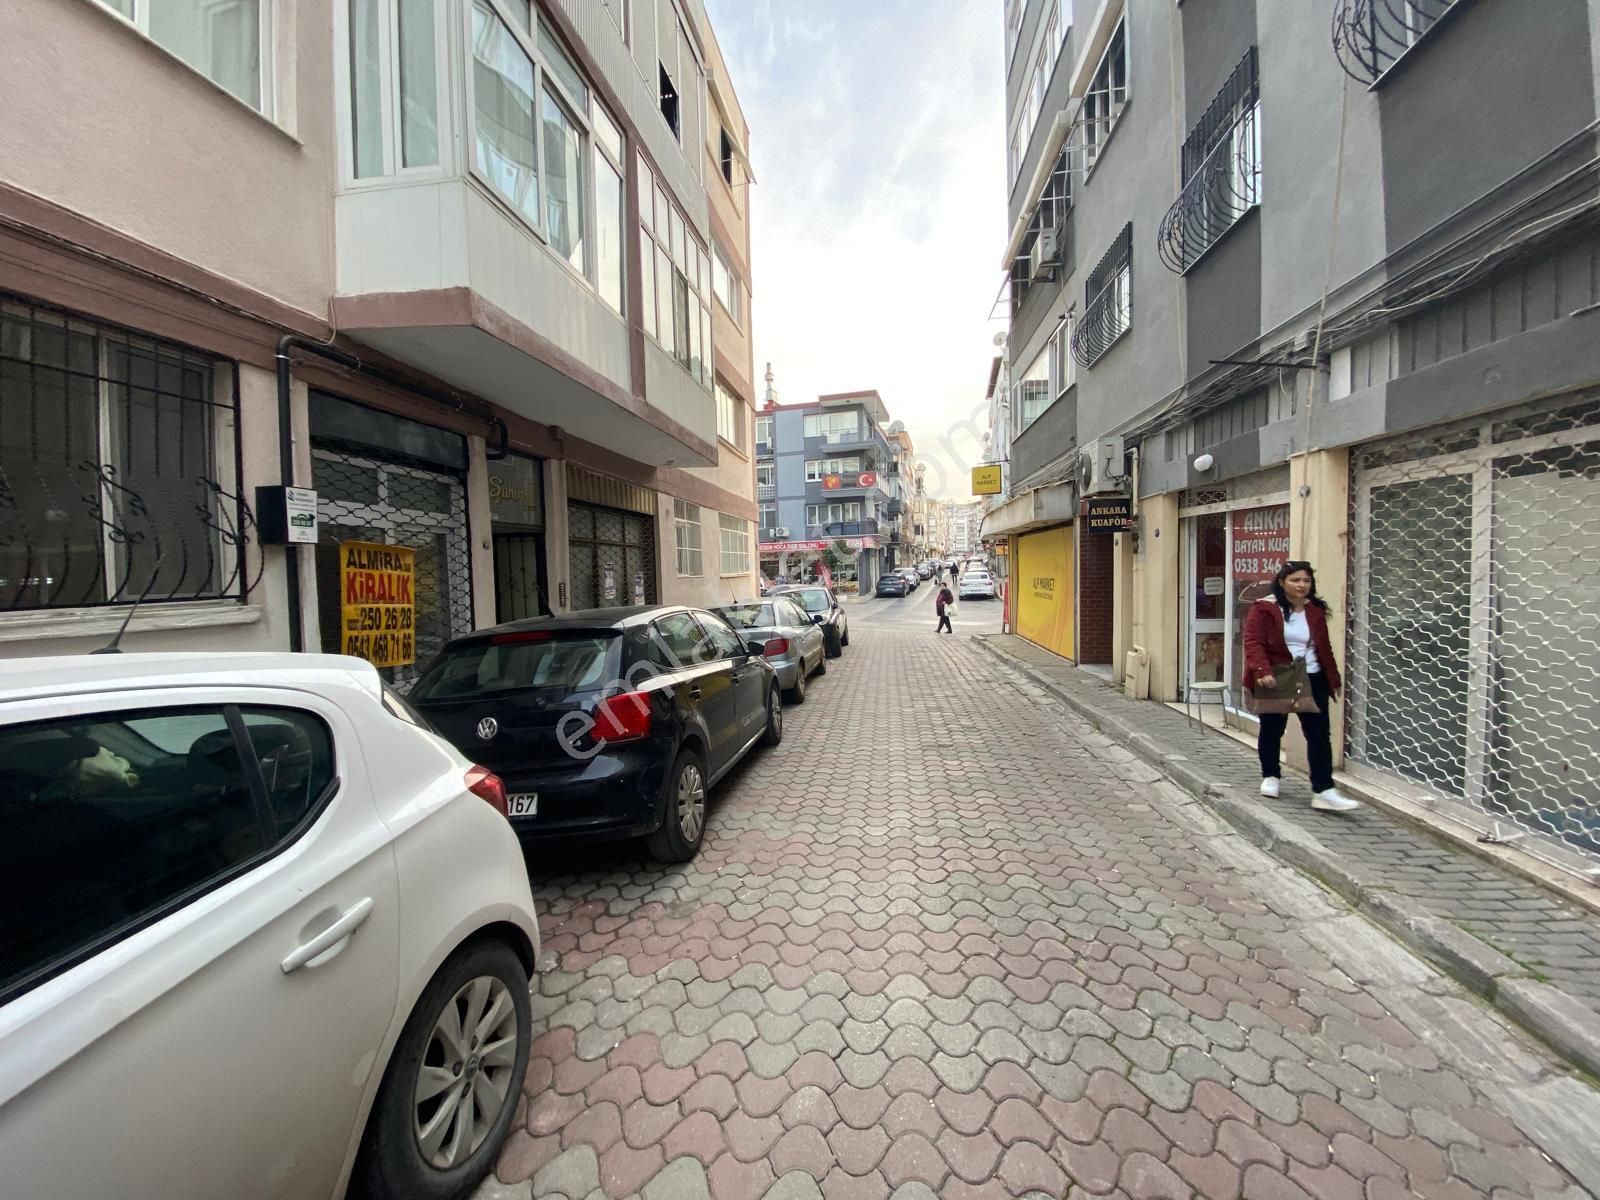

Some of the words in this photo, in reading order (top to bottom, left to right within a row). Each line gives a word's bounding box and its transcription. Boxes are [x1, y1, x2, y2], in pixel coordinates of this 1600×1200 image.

[1091, 507, 1127, 515] ANKARA
[1091, 516, 1127, 527] KUAFÖR
[1234, 539, 1265, 554] BAYAN
[1234, 558, 1259, 574] 0538
[1261, 558, 1282, 574] 346
[1040, 577, 1055, 592] MARKET
[360, 607, 382, 630] 250
[384, 607, 398, 630] 26
[400, 607, 412, 629] 28
[347, 634, 370, 660] 0543
[372, 633, 389, 662] 468
[391, 633, 400, 661] 71
[402, 632, 412, 660] 66
[508, 796, 535, 814] 167
